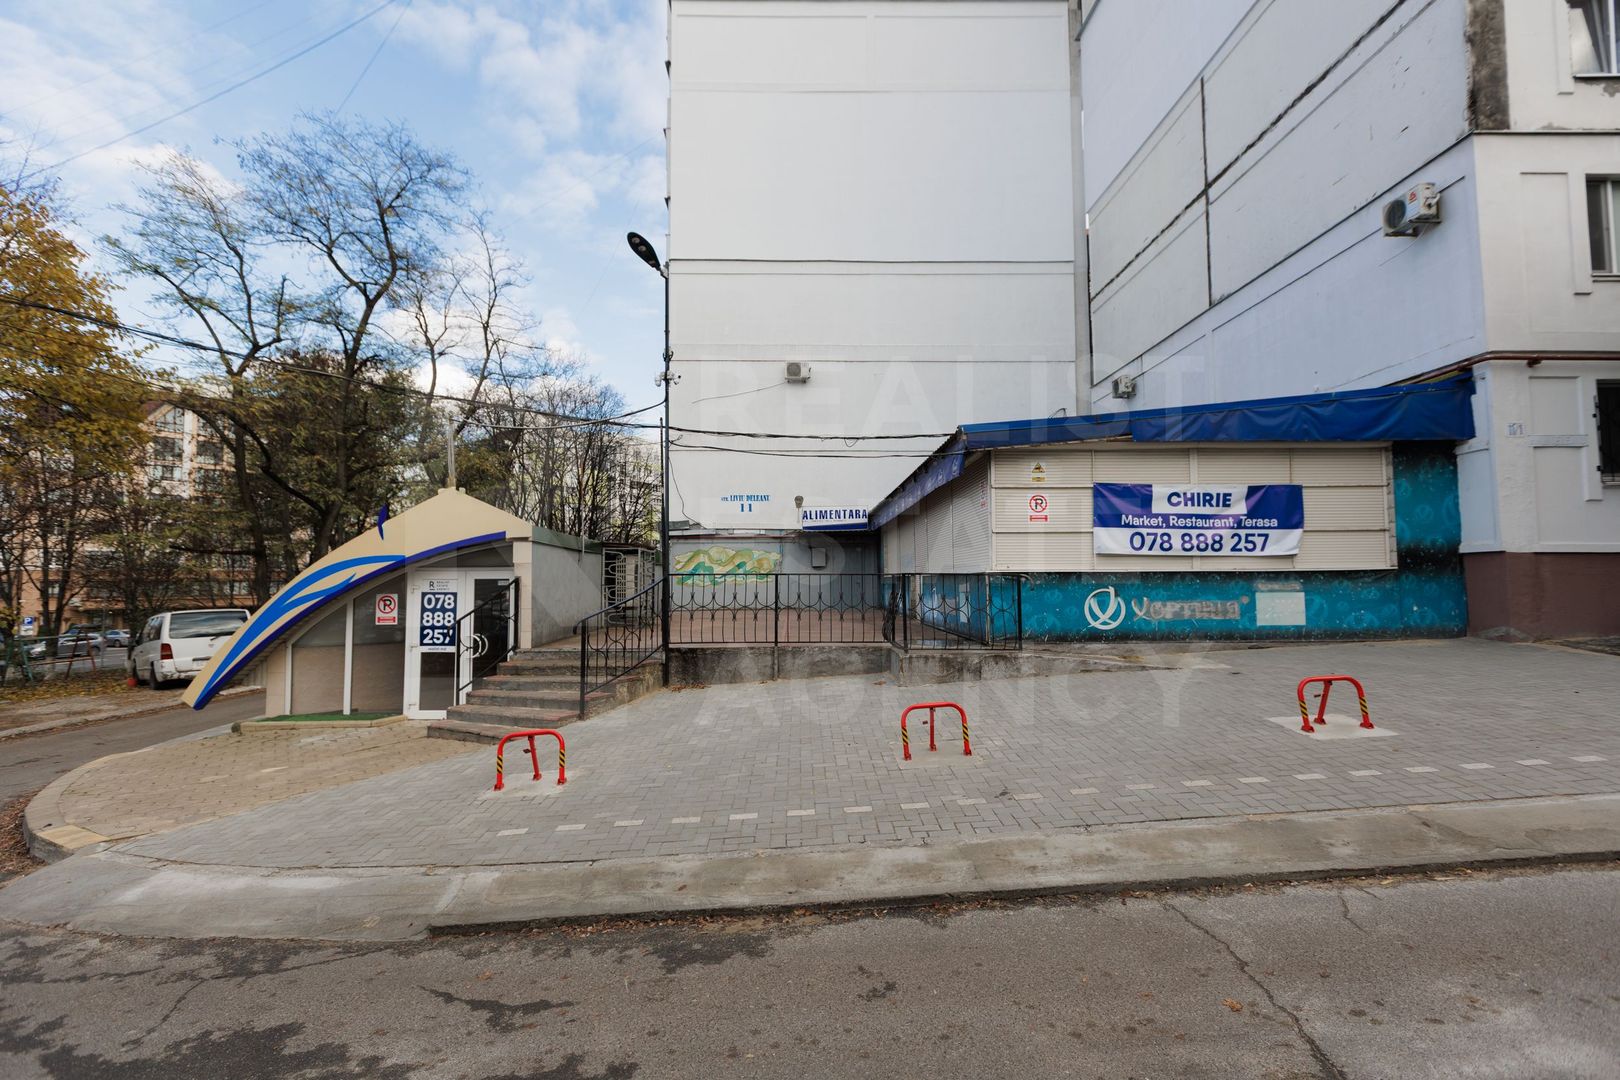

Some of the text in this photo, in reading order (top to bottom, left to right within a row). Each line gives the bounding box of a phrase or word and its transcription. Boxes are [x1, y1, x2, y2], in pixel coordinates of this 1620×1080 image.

[1167, 491, 1233, 508] CHIRIE
[802, 507, 868, 520] ALIMENTARA
[1121, 514, 1278, 529] Market, Restaurant, Terasa
[1129, 531, 1270, 553] 078 888 257
[423, 594, 455, 609] 078
[422, 611, 455, 627] 888
[422, 628, 454, 644] 257
